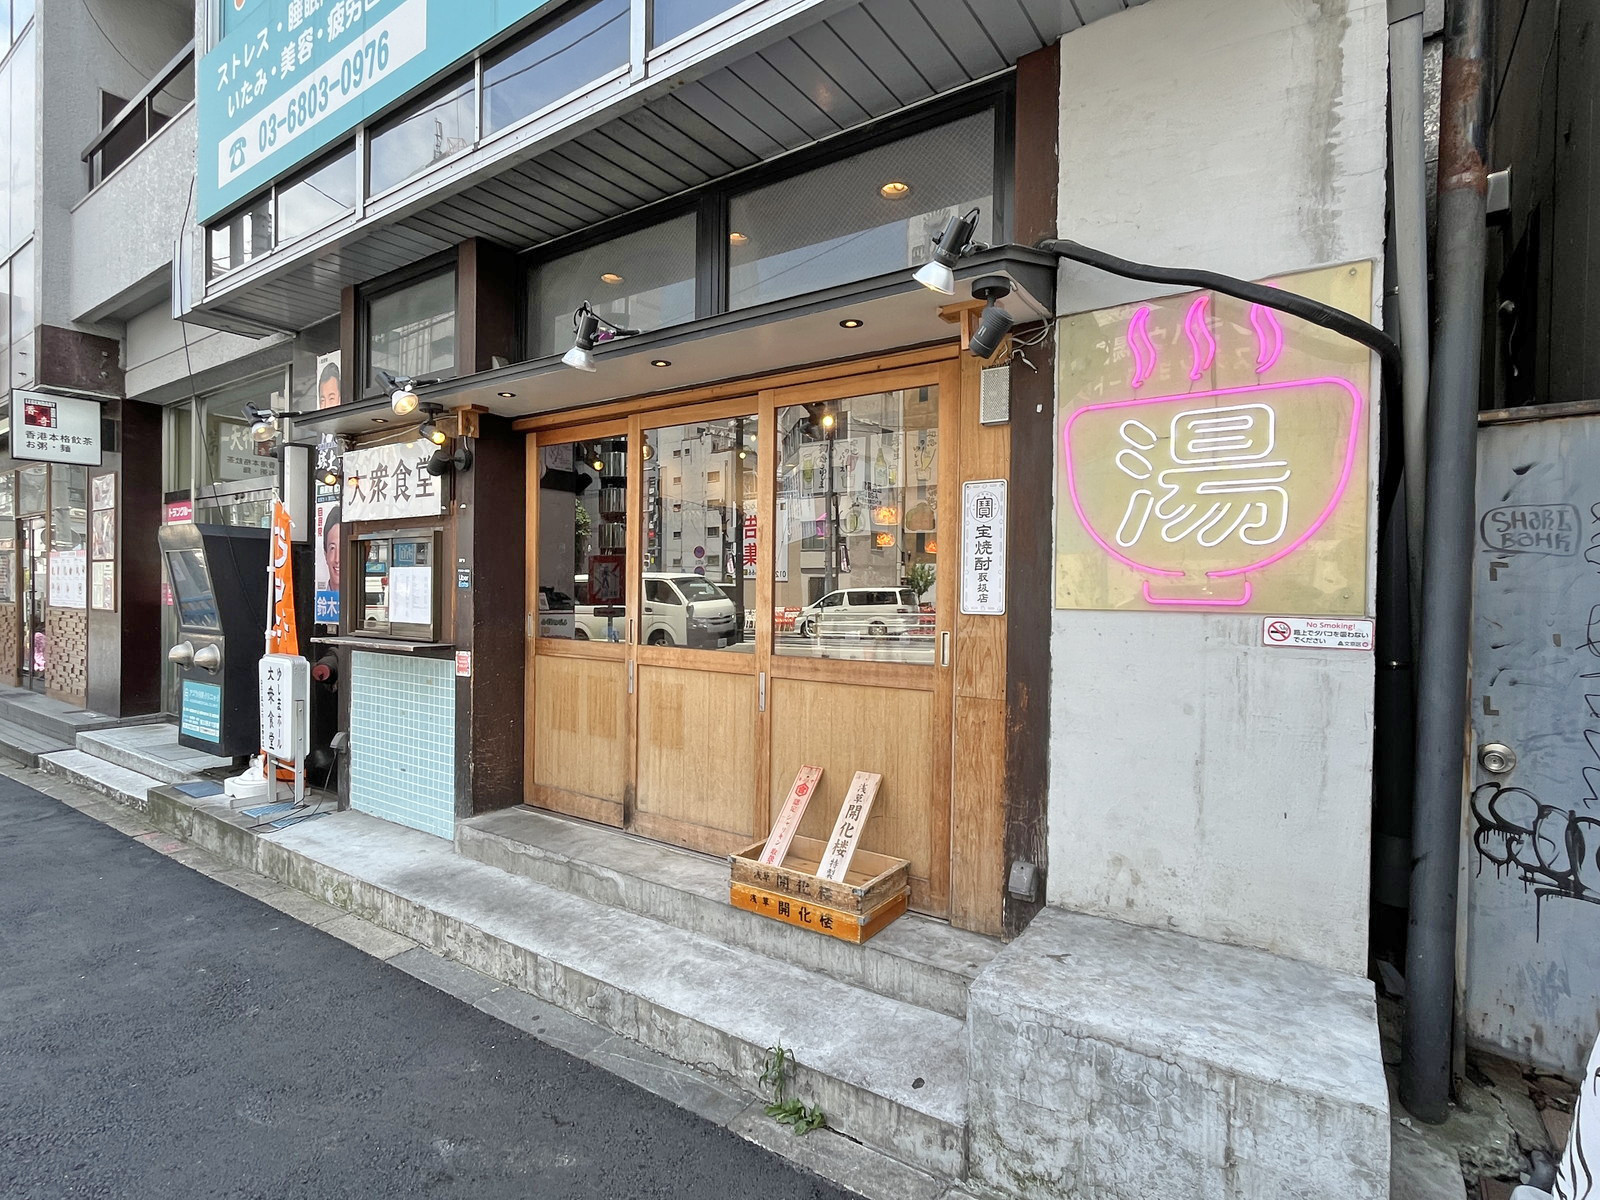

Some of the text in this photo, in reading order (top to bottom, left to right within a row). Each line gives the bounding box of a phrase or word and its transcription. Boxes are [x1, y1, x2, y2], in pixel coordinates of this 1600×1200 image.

[258, 30, 389, 153] 03-6803-0976
[25, 430, 93, 446] 香港本格飲茶
[25, 440, 72, 453] お粥・麺
[347, 454, 435, 507] 大衆食堂
[1115, 402, 1292, 548] 湯
[974, 524, 993, 604] 宝焼酎取扱店
[458, 574, 470, 582] Uber
[316, 596, 340, 618] 鈴木
[1293, 629, 1369, 639] 路上でタバコを吸わない
[1319, 621, 1356, 631] Smoking!
[1293, 636, 1327, 644] でください
[267, 665, 275, 751] 大衆食堂
